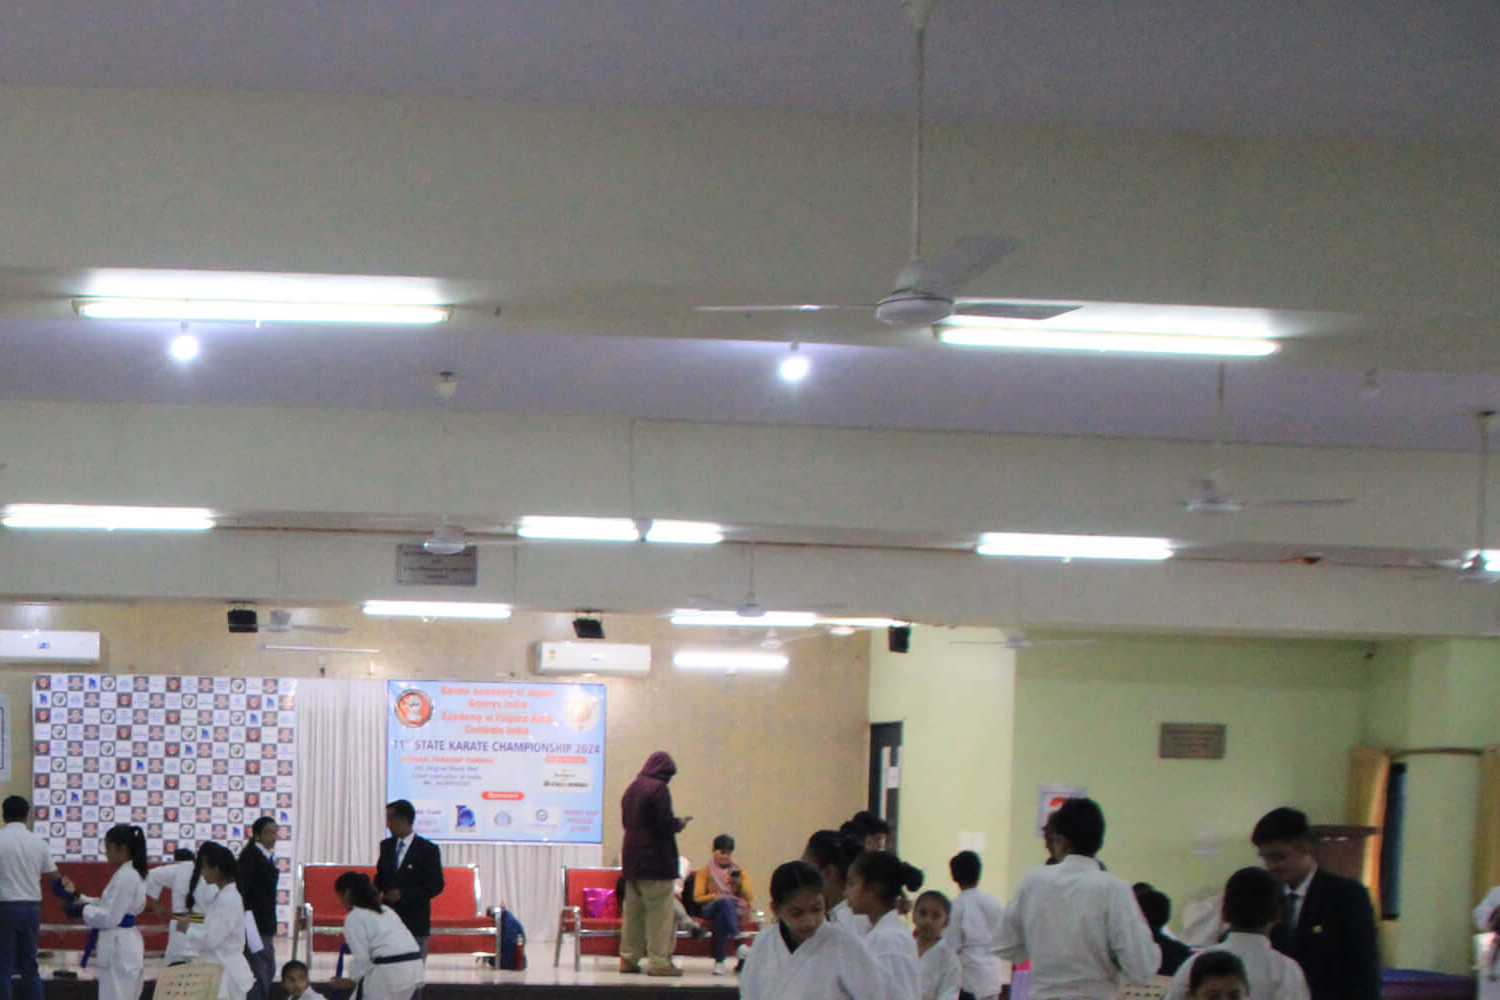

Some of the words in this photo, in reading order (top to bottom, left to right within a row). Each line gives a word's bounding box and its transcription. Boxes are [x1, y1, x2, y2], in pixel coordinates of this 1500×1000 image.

[414, 740, 445, 751] STATE
[448, 740, 488, 752] KARATE
[491, 741, 572, 754] CHAMPIONSHIP
[575, 743, 600, 754] 2024
